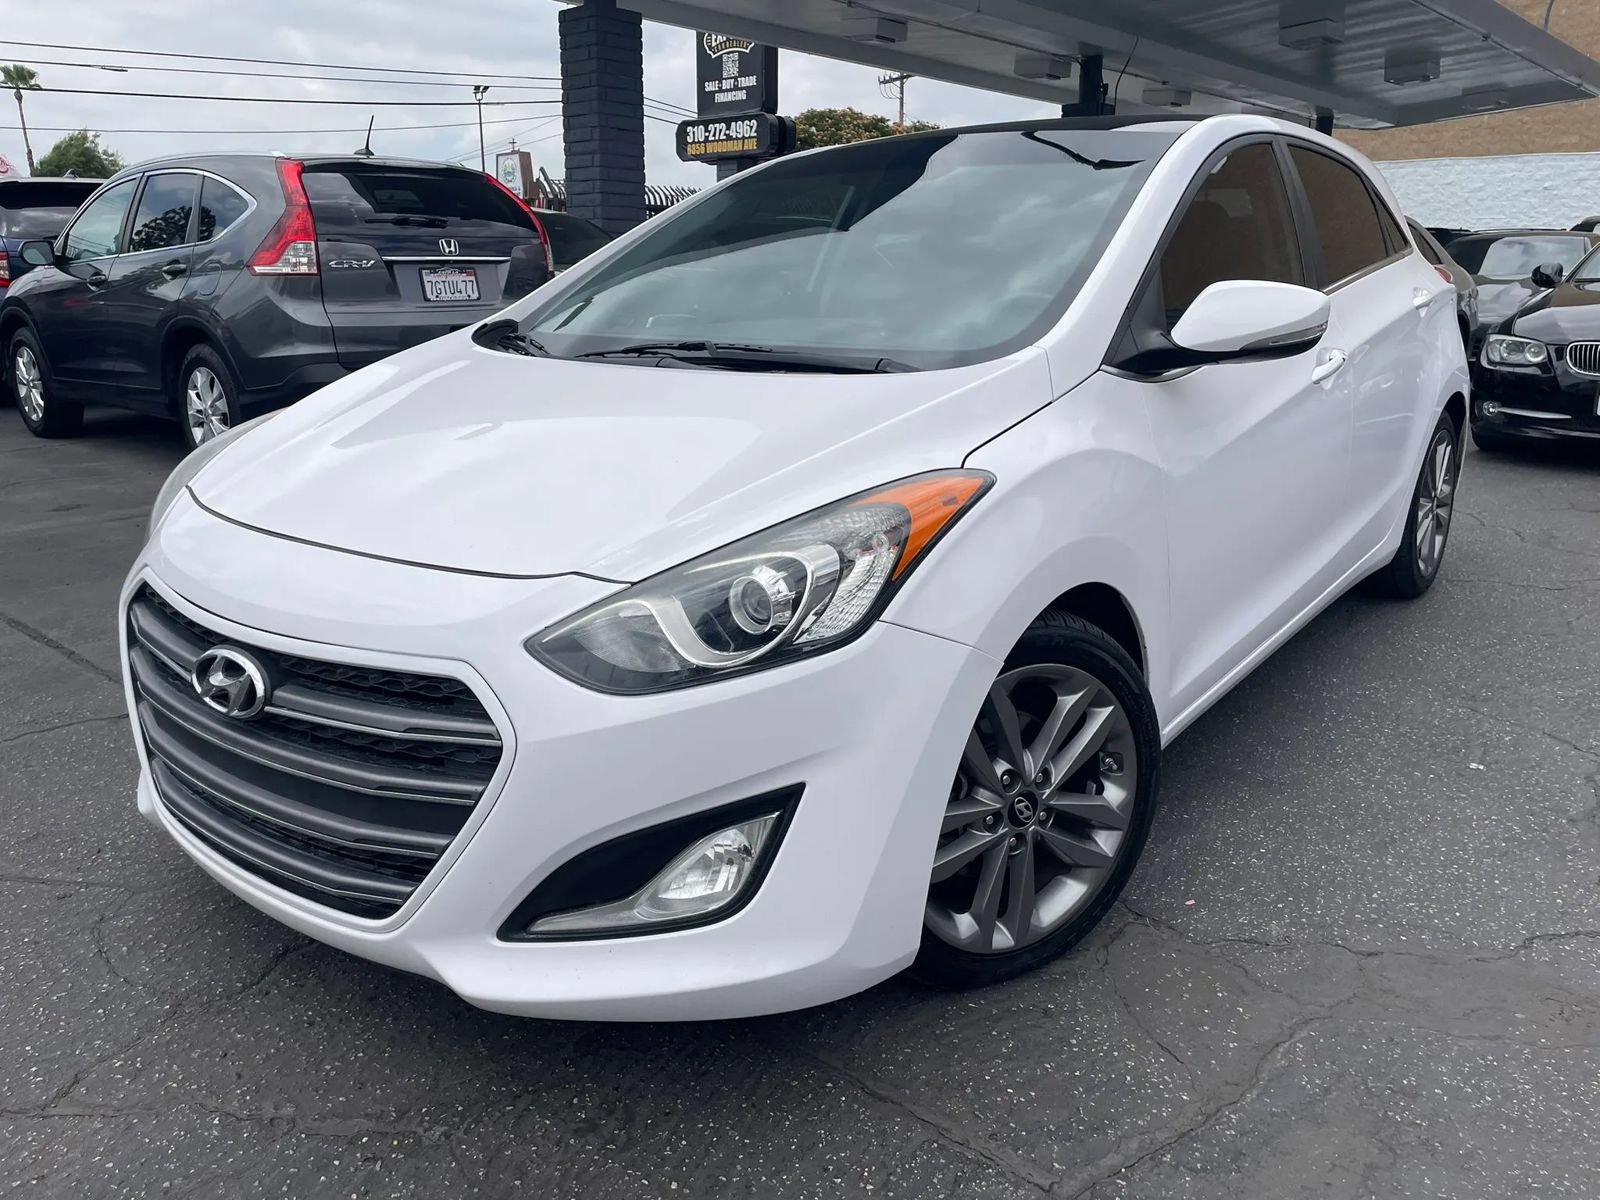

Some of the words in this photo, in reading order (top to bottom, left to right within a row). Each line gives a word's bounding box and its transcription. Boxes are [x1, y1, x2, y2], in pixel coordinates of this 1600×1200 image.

[704, 81, 719, 92] SALE
[722, 78, 735, 90] BUY
[738, 76, 757, 87] TRADE
[715, 90, 746, 103] FINANCING
[687, 120, 757, 142] 310-272-4962
[706, 140, 742, 153] WOODMAN
[743, 138, 757, 150] AVE
[426, 279, 475, 296] 7GTU477
